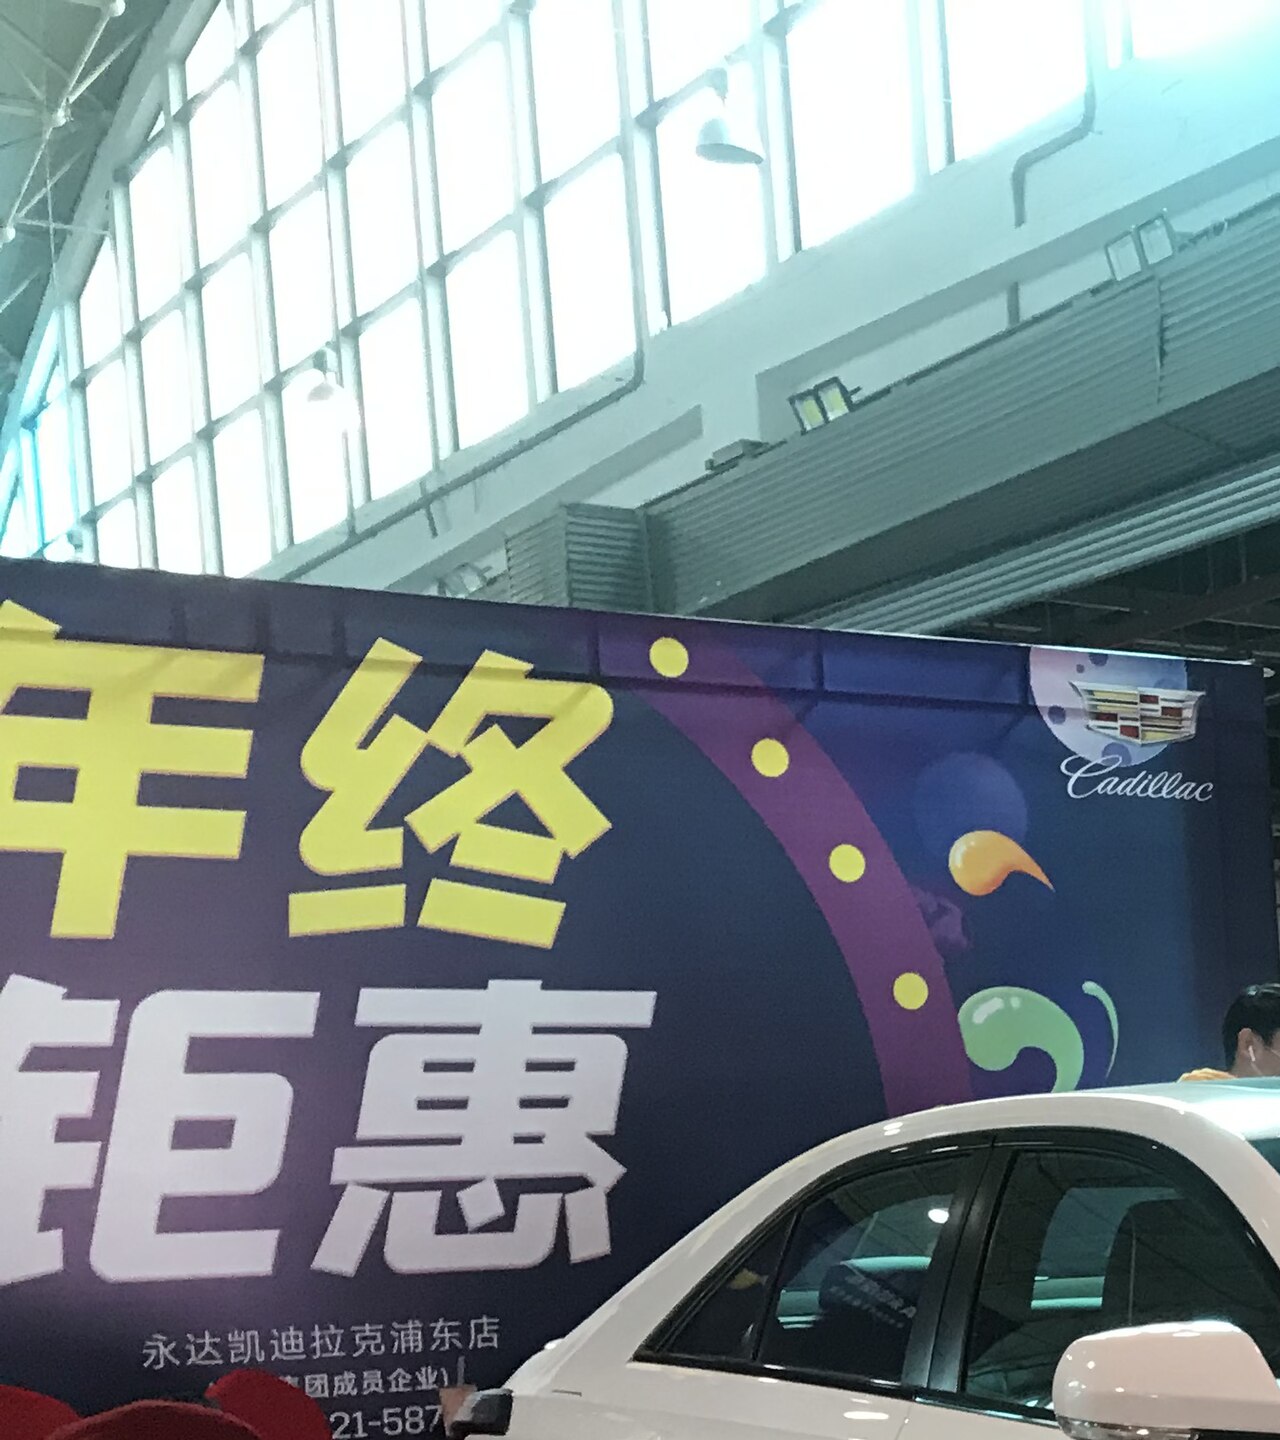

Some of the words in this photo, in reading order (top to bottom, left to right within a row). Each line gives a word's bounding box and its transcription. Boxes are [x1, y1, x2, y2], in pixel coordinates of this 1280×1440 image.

[0, 598, 613, 949] 年终
[1060, 753, 1214, 802] Cadillac
[0, 973, 657, 1286] 钜惠
[142, 1314, 500, 1370] 永达凯迪拉克浦东店
